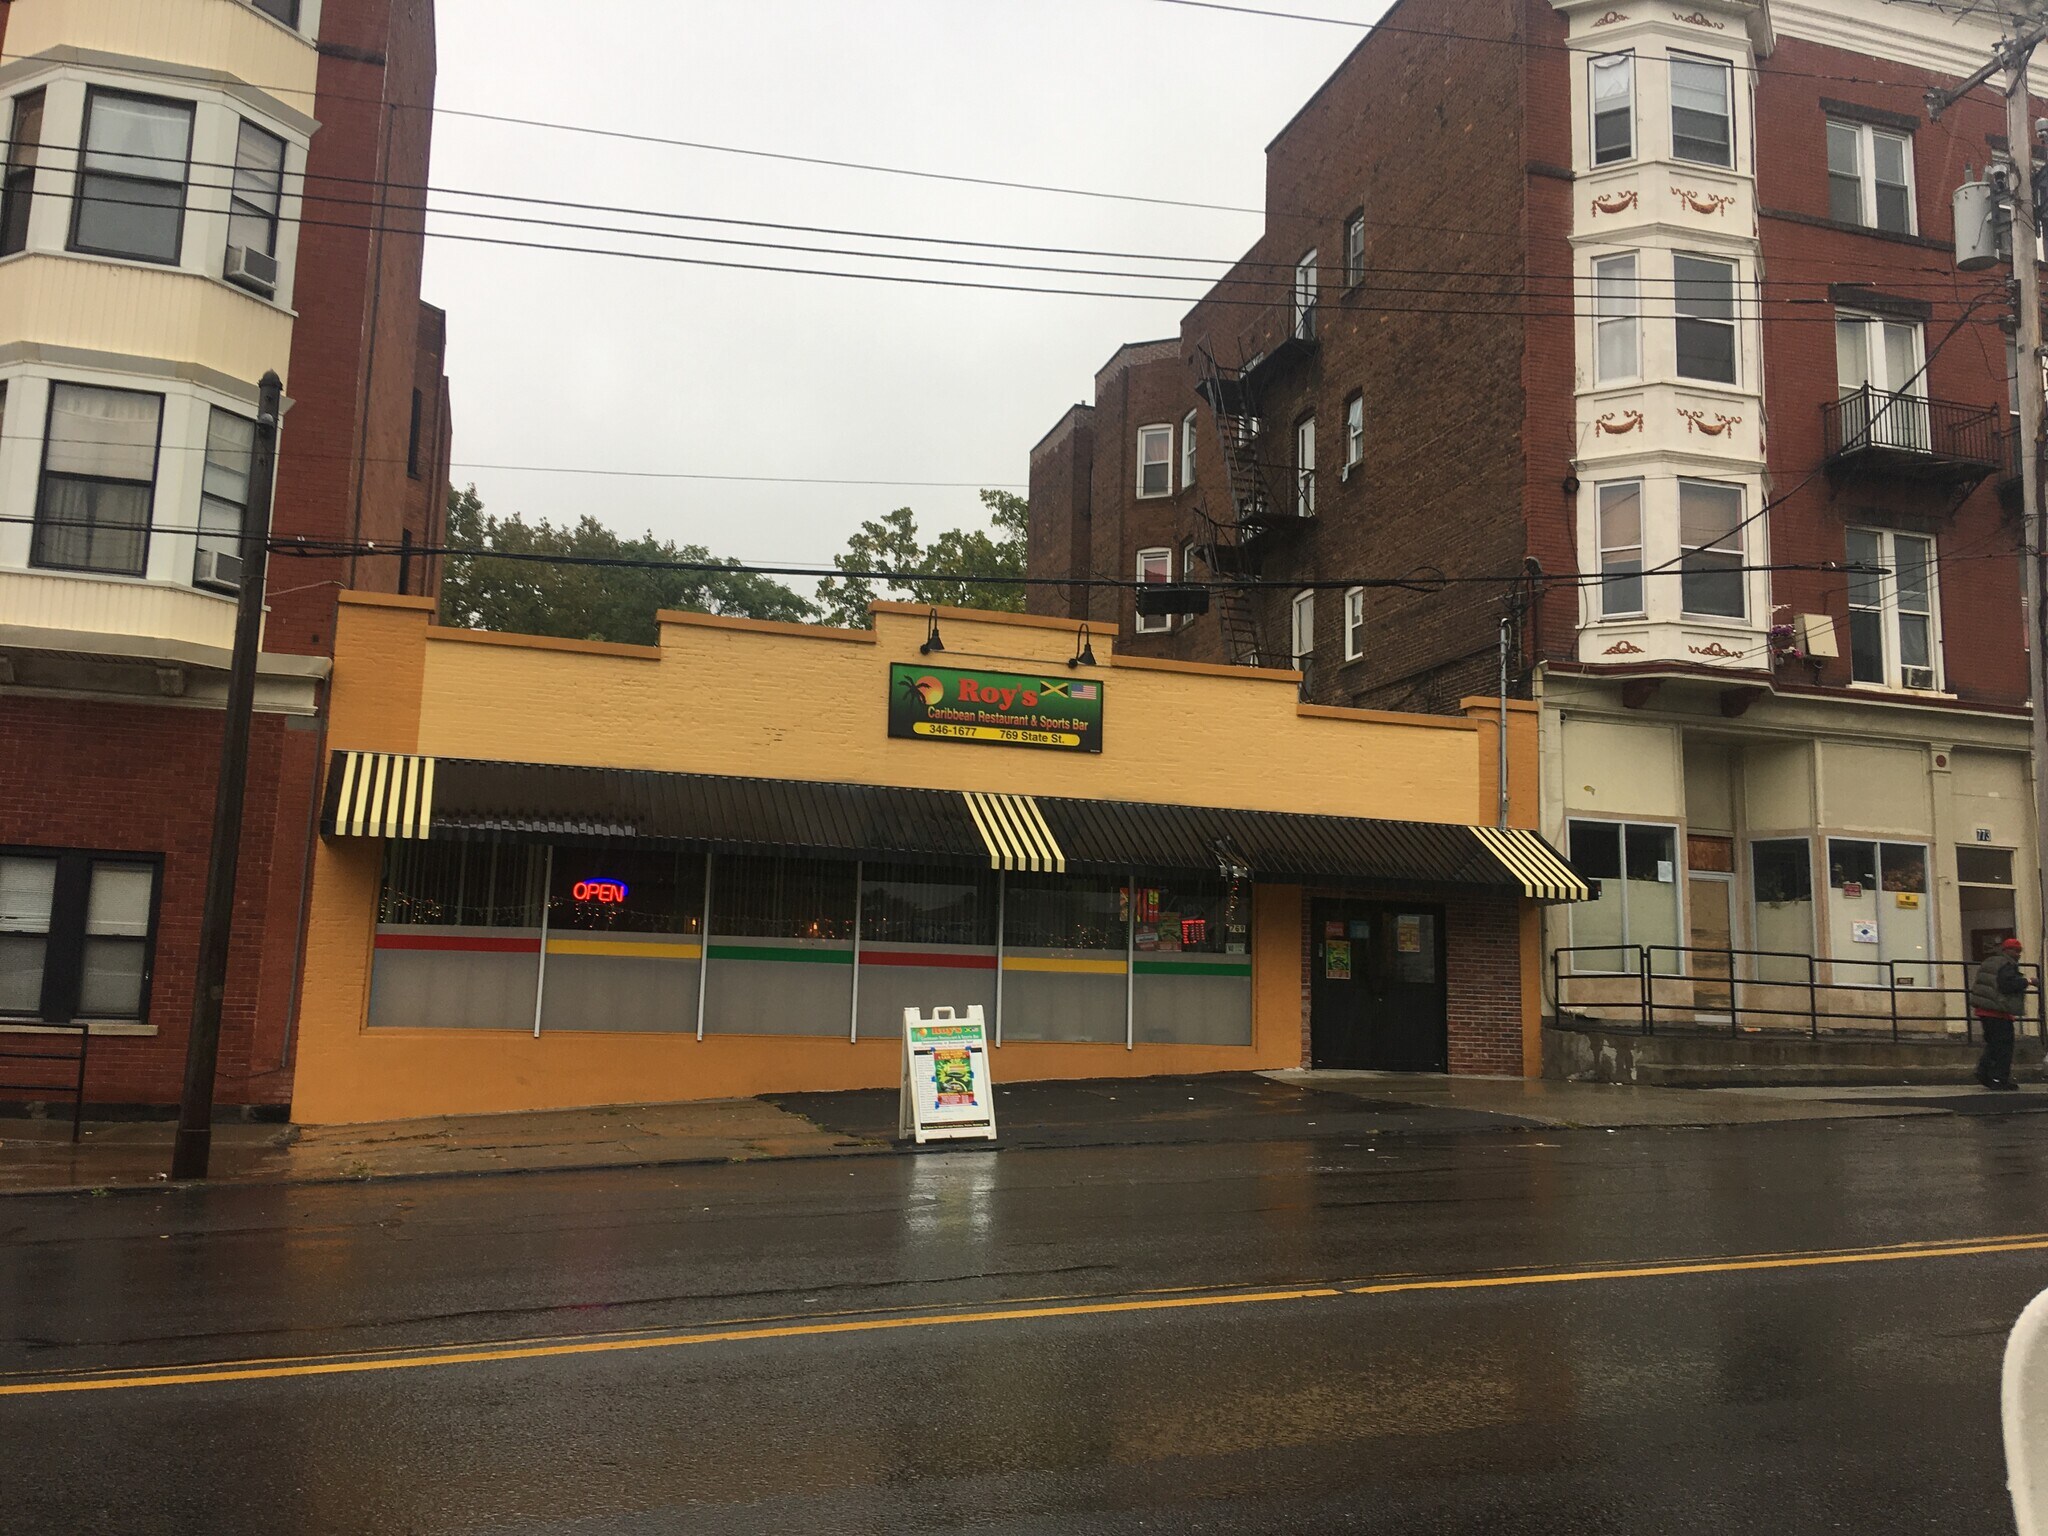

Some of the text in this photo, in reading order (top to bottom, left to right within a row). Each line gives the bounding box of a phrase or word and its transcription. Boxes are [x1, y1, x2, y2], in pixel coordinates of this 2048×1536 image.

[957, 677, 1039, 711] Roy's
[927, 705, 1089, 731] Caribbean Restaurant & Sports Bar
[929, 724, 1065, 744] 346-1677 769 State St.
[573, 882, 625, 902] OPEN
